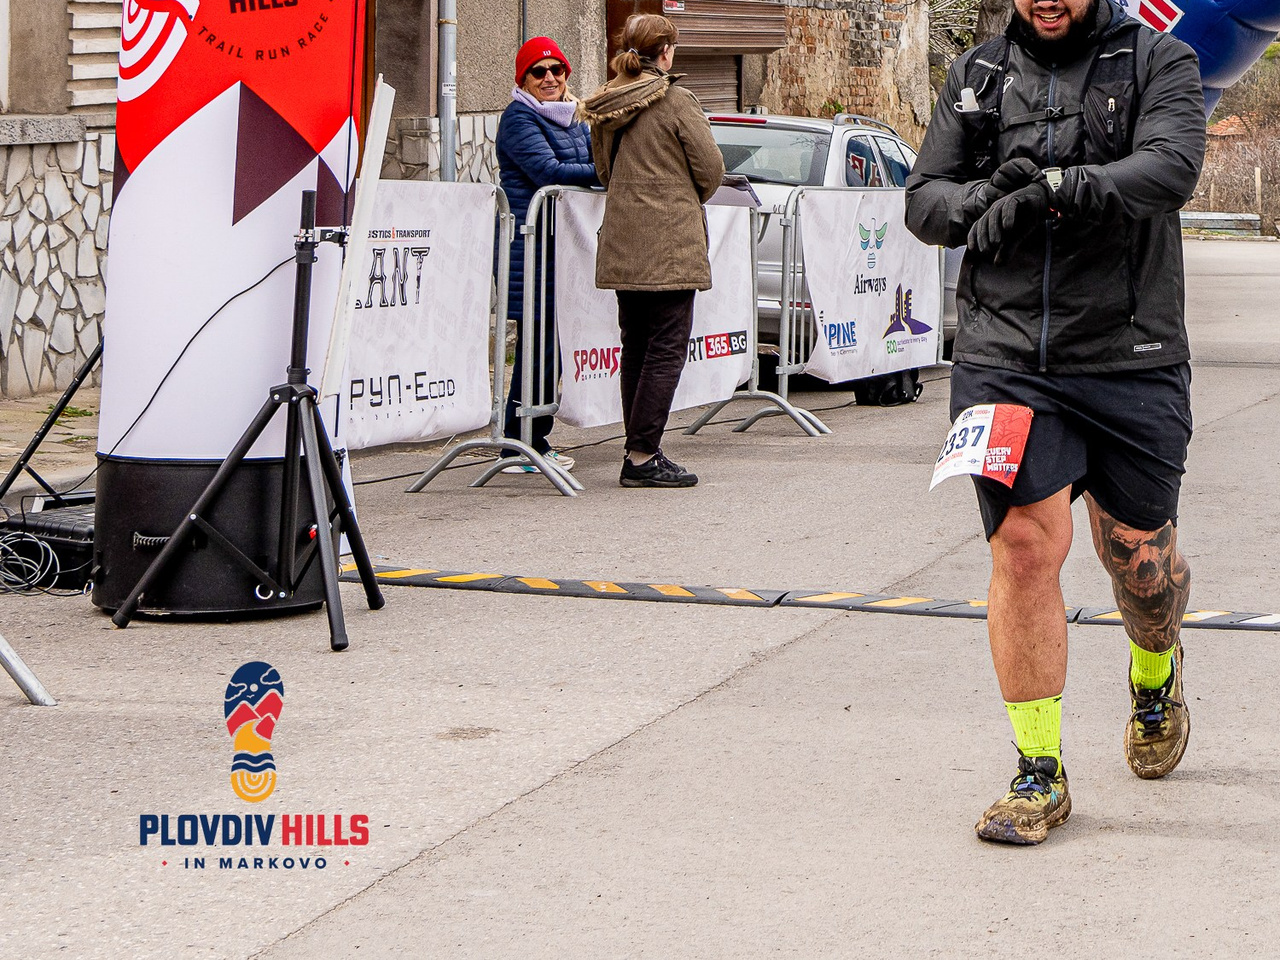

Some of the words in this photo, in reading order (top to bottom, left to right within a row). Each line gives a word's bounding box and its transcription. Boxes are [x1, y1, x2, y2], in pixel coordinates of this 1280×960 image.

[198, 26, 244, 60] TRAIL
[255, 46, 290, 61] RUN
[298, 13, 328, 49] RACE
[395, 229, 431, 239] TRANSPORT
[354, 247, 430, 309] ANT
[854, 274, 887, 297] Airways
[824, 321, 857, 347] PINE
[887, 340, 897, 354] ECO
[986, 447, 1011, 455] EVERY
[986, 464, 1018, 472] MATTERS
